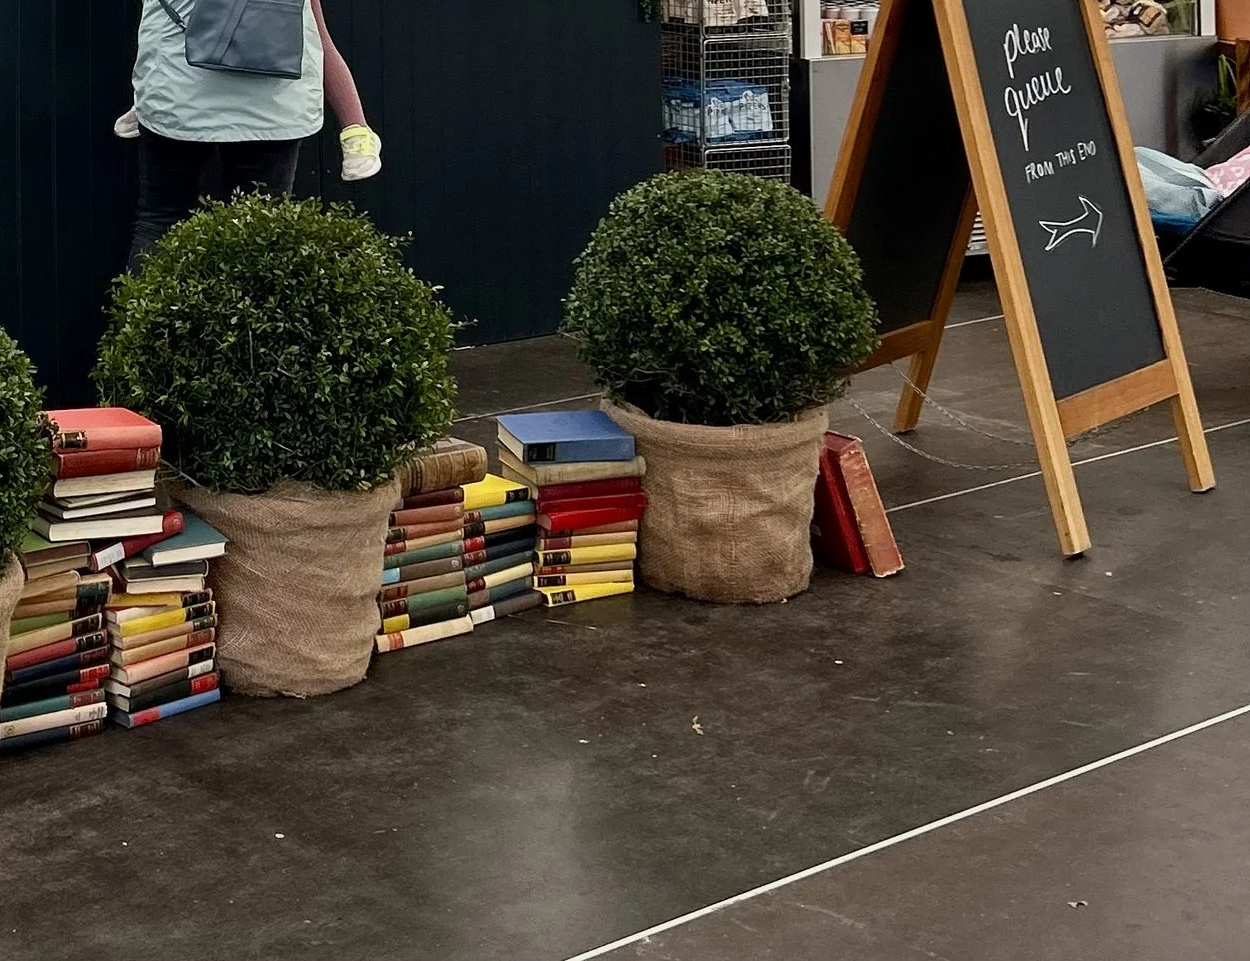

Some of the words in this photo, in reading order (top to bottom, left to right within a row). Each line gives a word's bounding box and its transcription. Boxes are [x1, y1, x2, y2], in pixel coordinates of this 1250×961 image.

[1004, 24, 1051, 78] please
[1004, 67, 1071, 151] queue
[1025, 160, 1054, 184] FROM
[1056, 150, 1076, 168] THIS
[1077, 140, 1096, 160] END
